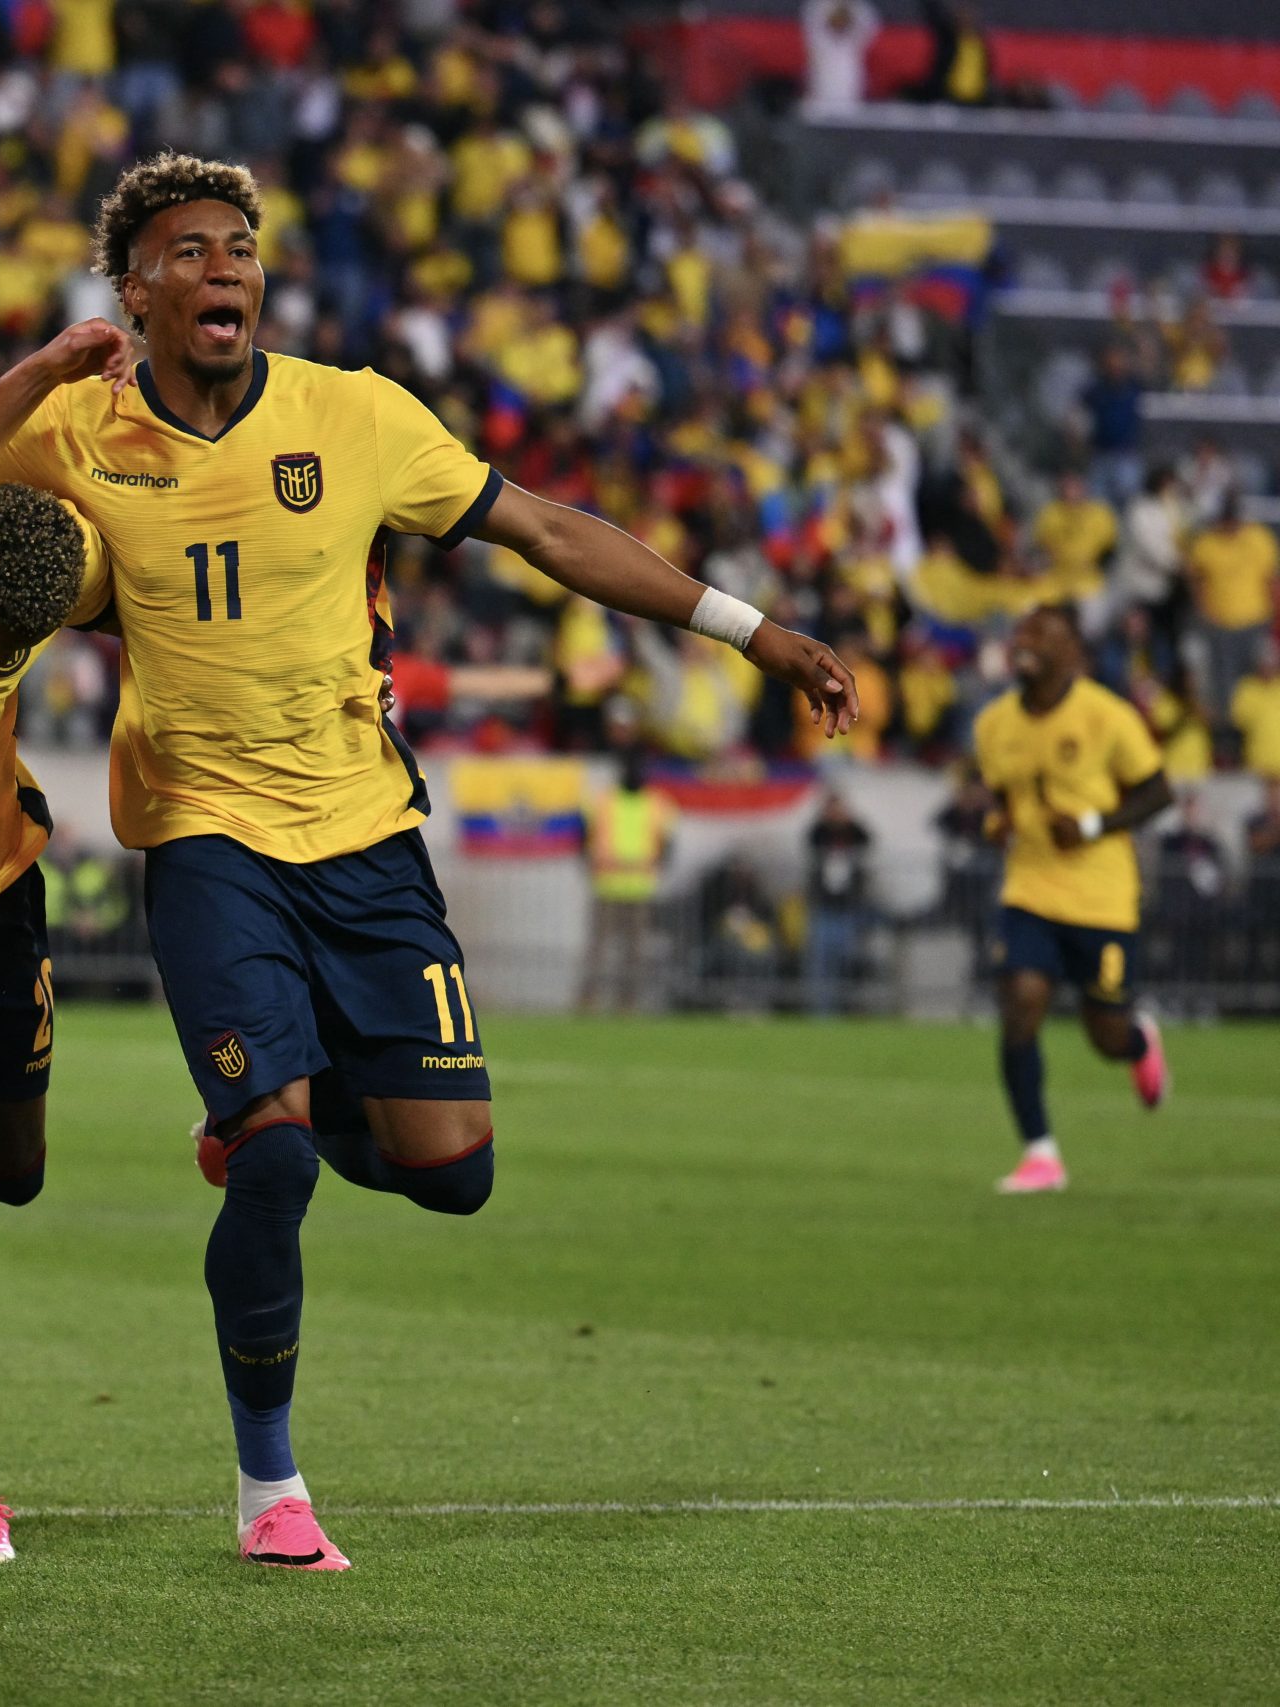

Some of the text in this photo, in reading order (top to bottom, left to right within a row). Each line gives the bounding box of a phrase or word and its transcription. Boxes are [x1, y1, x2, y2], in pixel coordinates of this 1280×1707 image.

[91, 467, 178, 488] marathon
[185, 540, 242, 621] 11
[422, 963, 474, 1044] 11
